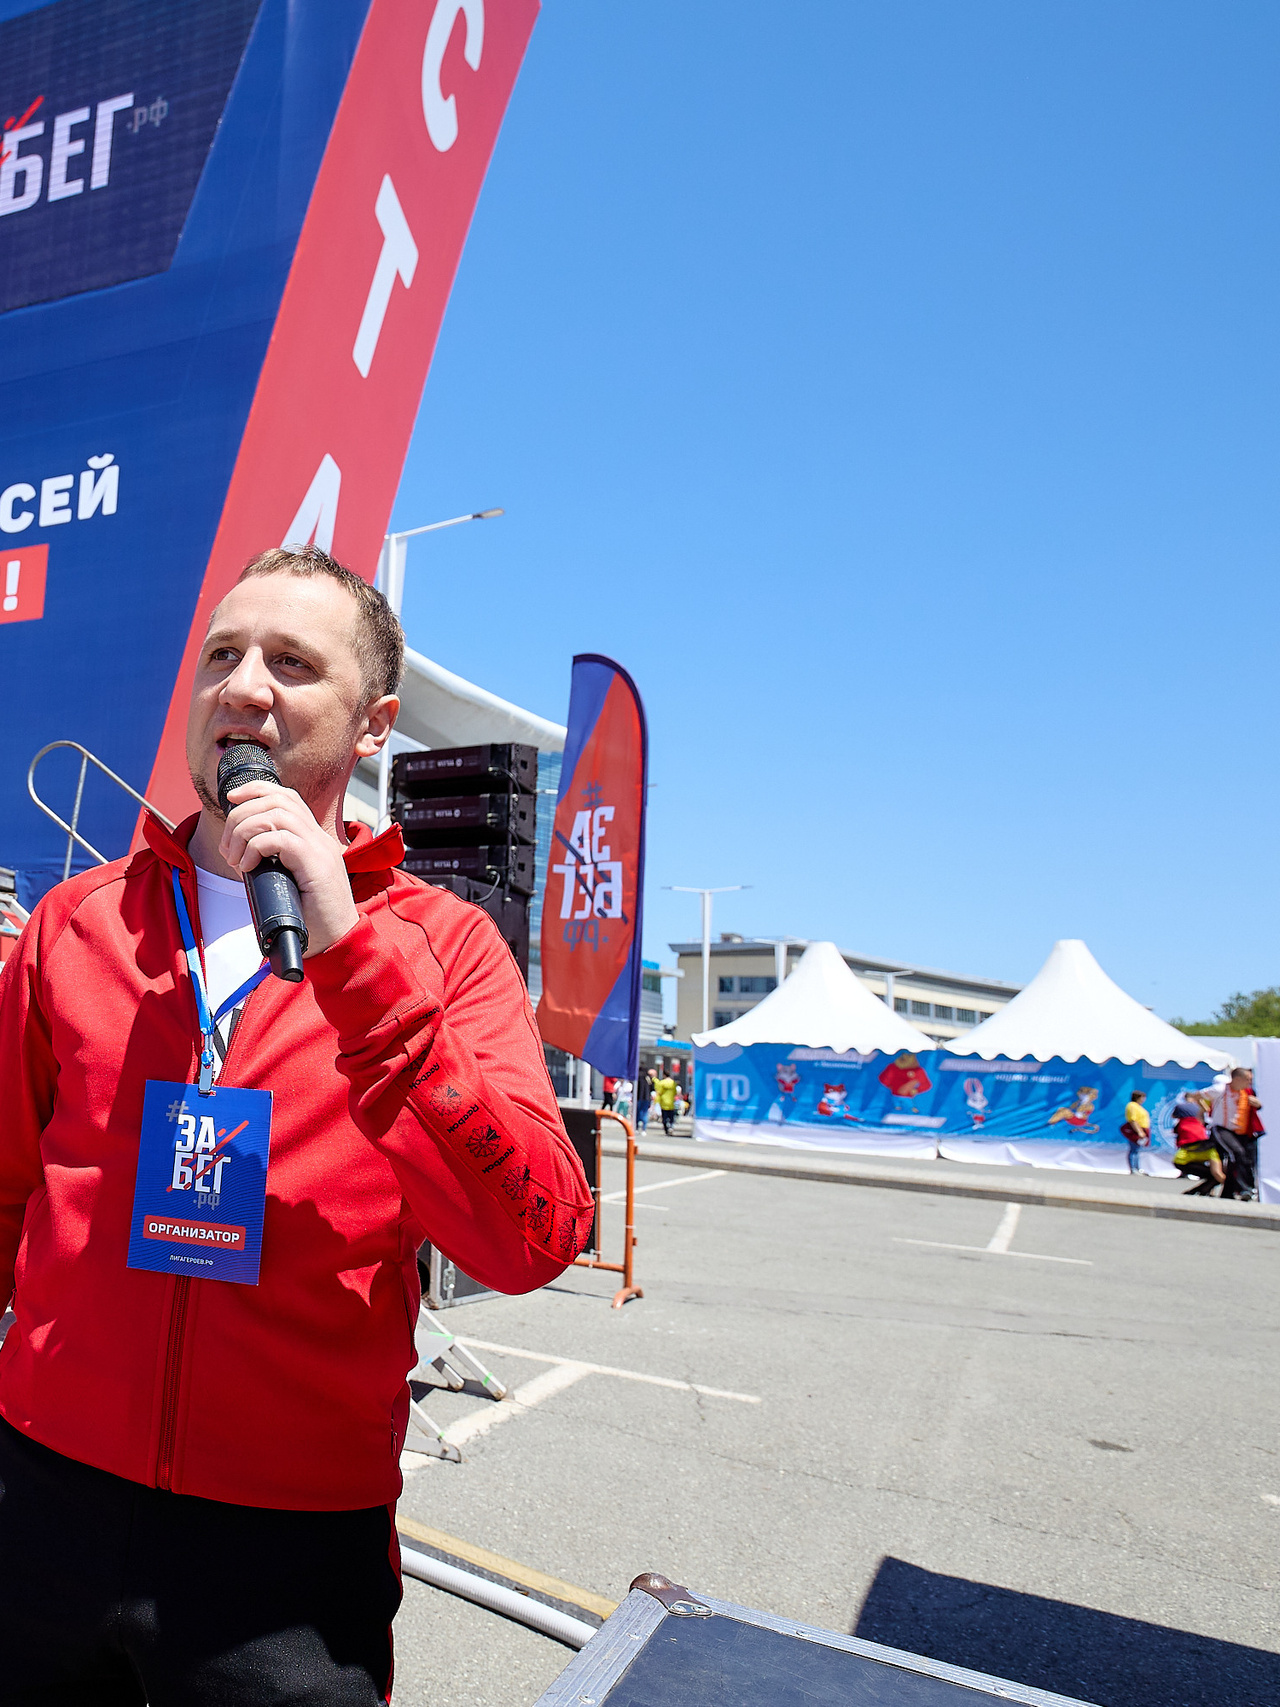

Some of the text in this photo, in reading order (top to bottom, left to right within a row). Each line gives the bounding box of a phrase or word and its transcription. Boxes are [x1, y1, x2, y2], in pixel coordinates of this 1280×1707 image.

[408, 1062, 440, 1090] Reebok
[446, 1104, 479, 1134] Reebok
[481, 1145, 515, 1174] Reebok
[148, 1221, 240, 1244] ОРГАНИЗАТОР
[169, 1254, 214, 1266] ЛИГАГЕРОЕВ.РФ
